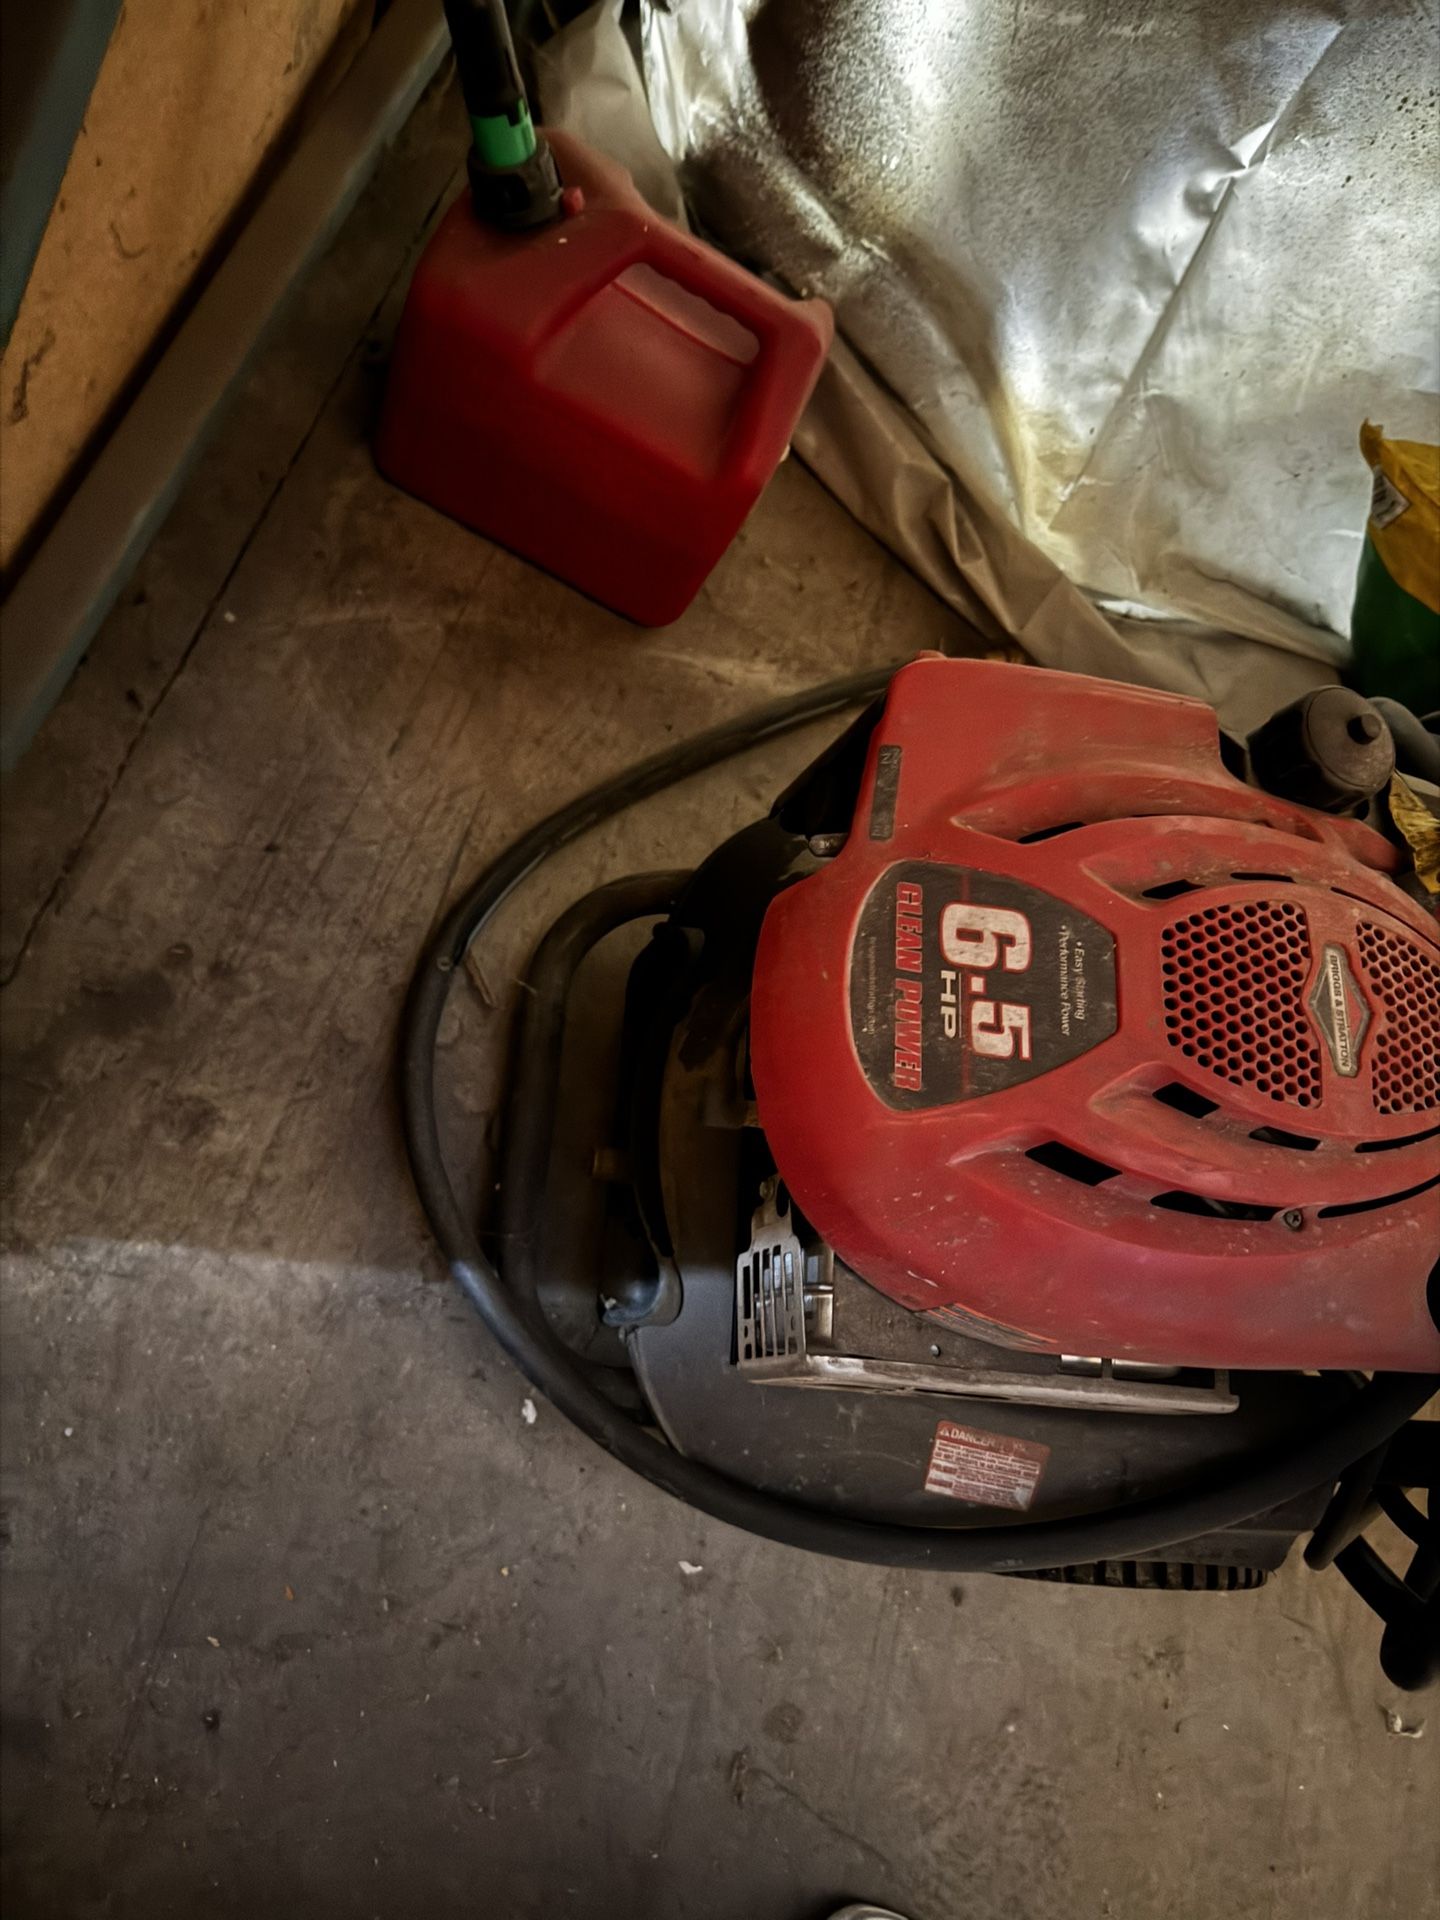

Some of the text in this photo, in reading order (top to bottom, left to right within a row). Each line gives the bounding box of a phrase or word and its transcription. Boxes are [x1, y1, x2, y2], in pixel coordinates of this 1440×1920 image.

[894, 881, 923, 1092] CLEAN POWER
[940, 902, 1032, 1061] 6.5
[940, 970, 957, 1039] HP
[1058, 931, 1071, 1036] Performance Power
[1073, 947, 1087, 1020] Easy Starting
[1329, 955, 1350, 1067] BRIGGS & STRATTON
